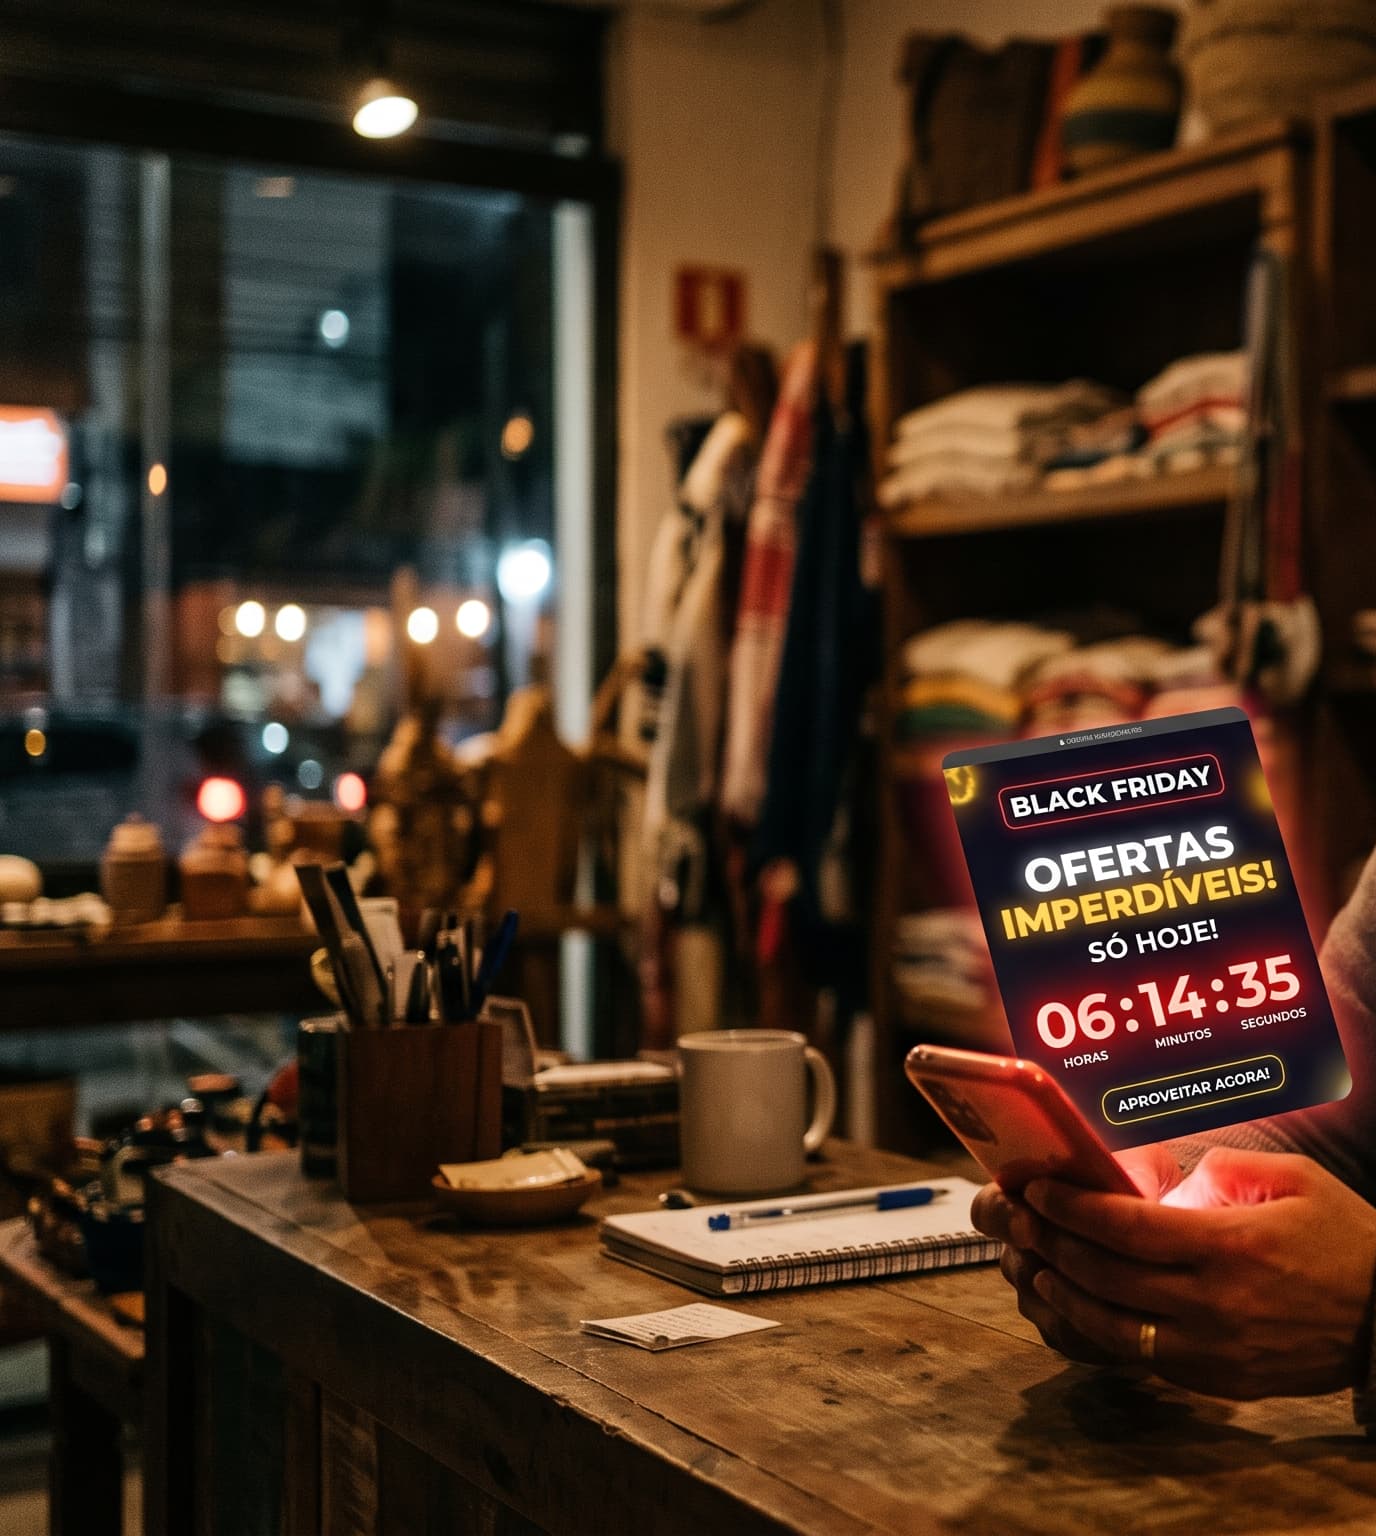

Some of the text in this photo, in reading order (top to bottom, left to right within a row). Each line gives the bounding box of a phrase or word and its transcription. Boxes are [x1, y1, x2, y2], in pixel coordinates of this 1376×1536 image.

[1010, 765, 1210, 818] BLACK FRIDAY
[1024, 825, 1235, 893] OFERTAS
[1000, 859, 1277, 940] IMPERDÍVEIS!
[1088, 918, 1219, 963] SÓ HOJE!
[1036, 954, 1300, 1049] 06:14:35
[1063, 1007, 1307, 1069] HORAS MINUTOS SEGUNDOS
[1118, 1067, 1271, 1113] APROVEITAR AGORA!
